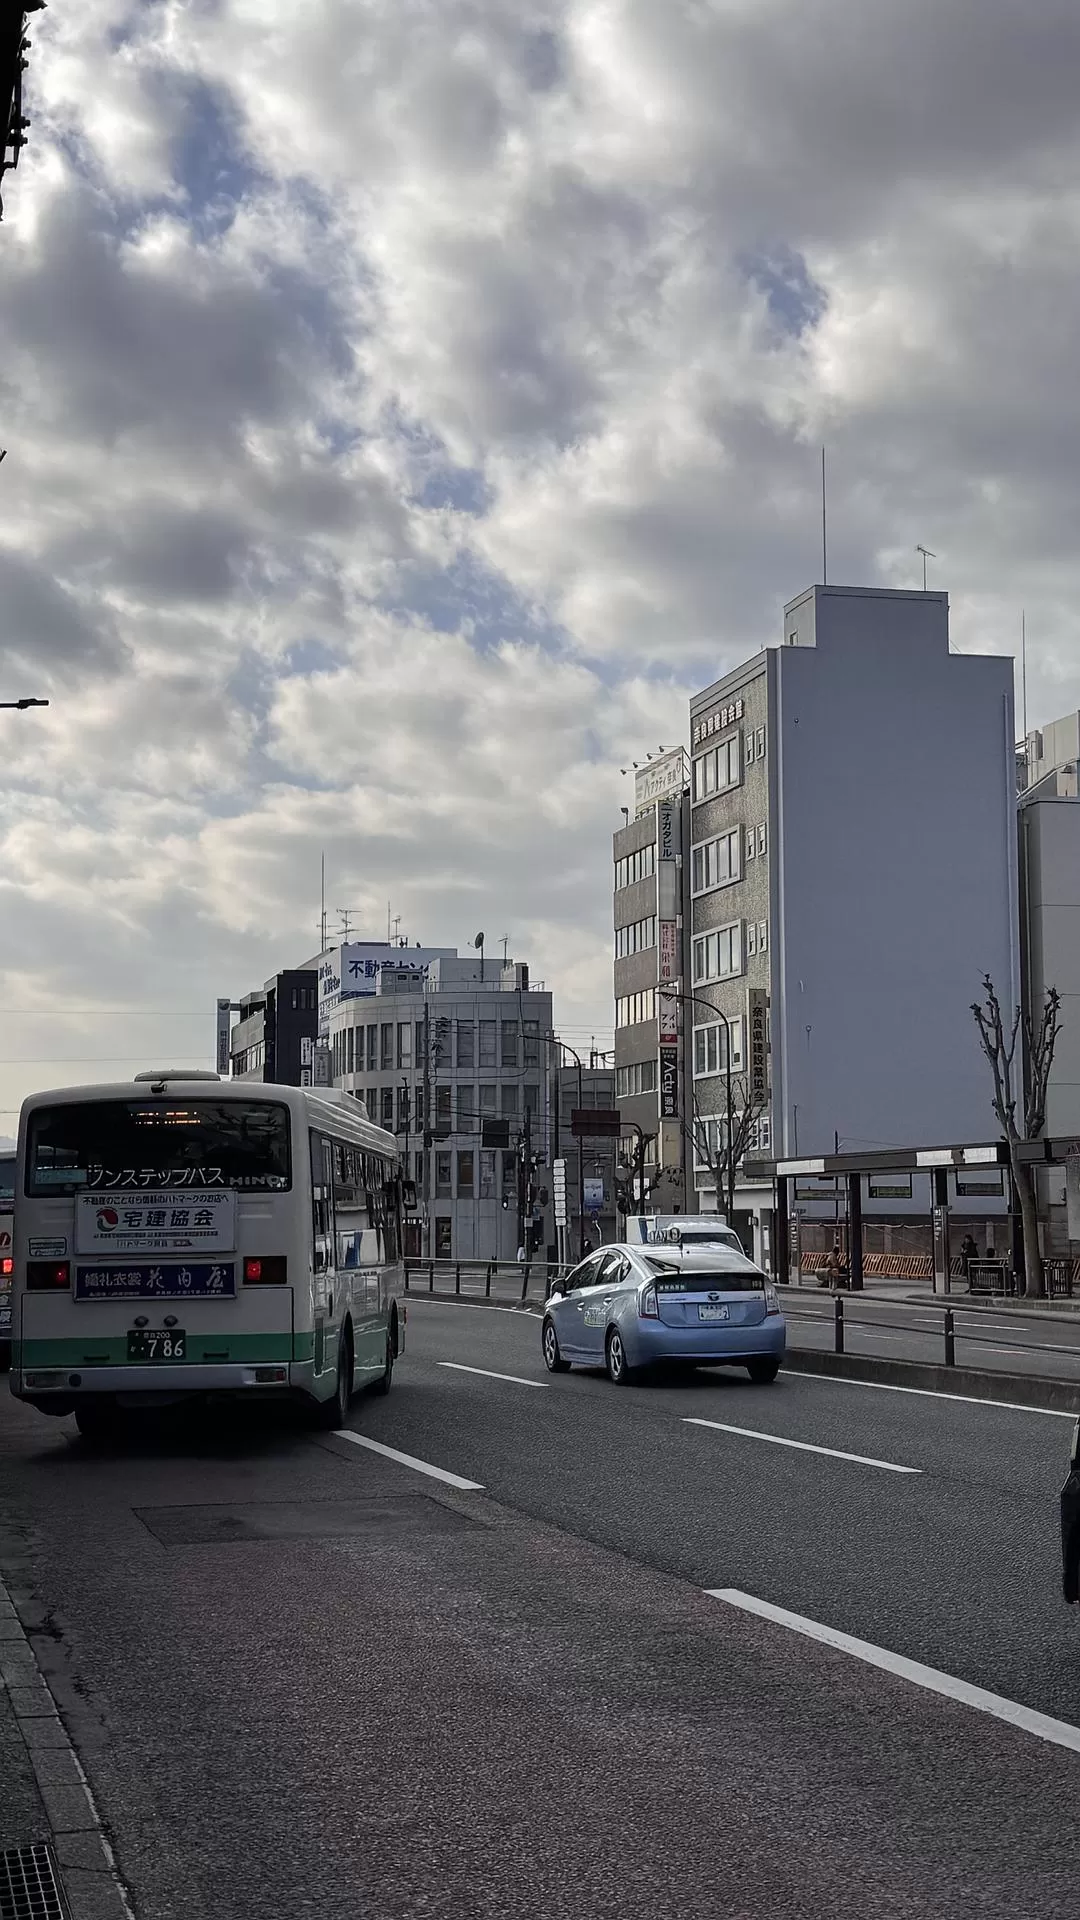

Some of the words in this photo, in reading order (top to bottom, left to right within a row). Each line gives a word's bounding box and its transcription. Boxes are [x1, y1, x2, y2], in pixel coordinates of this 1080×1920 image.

[752, 1006, 764, 1102] 奈良県建設業協会
[122, 1209, 214, 1228] 宅建協会
